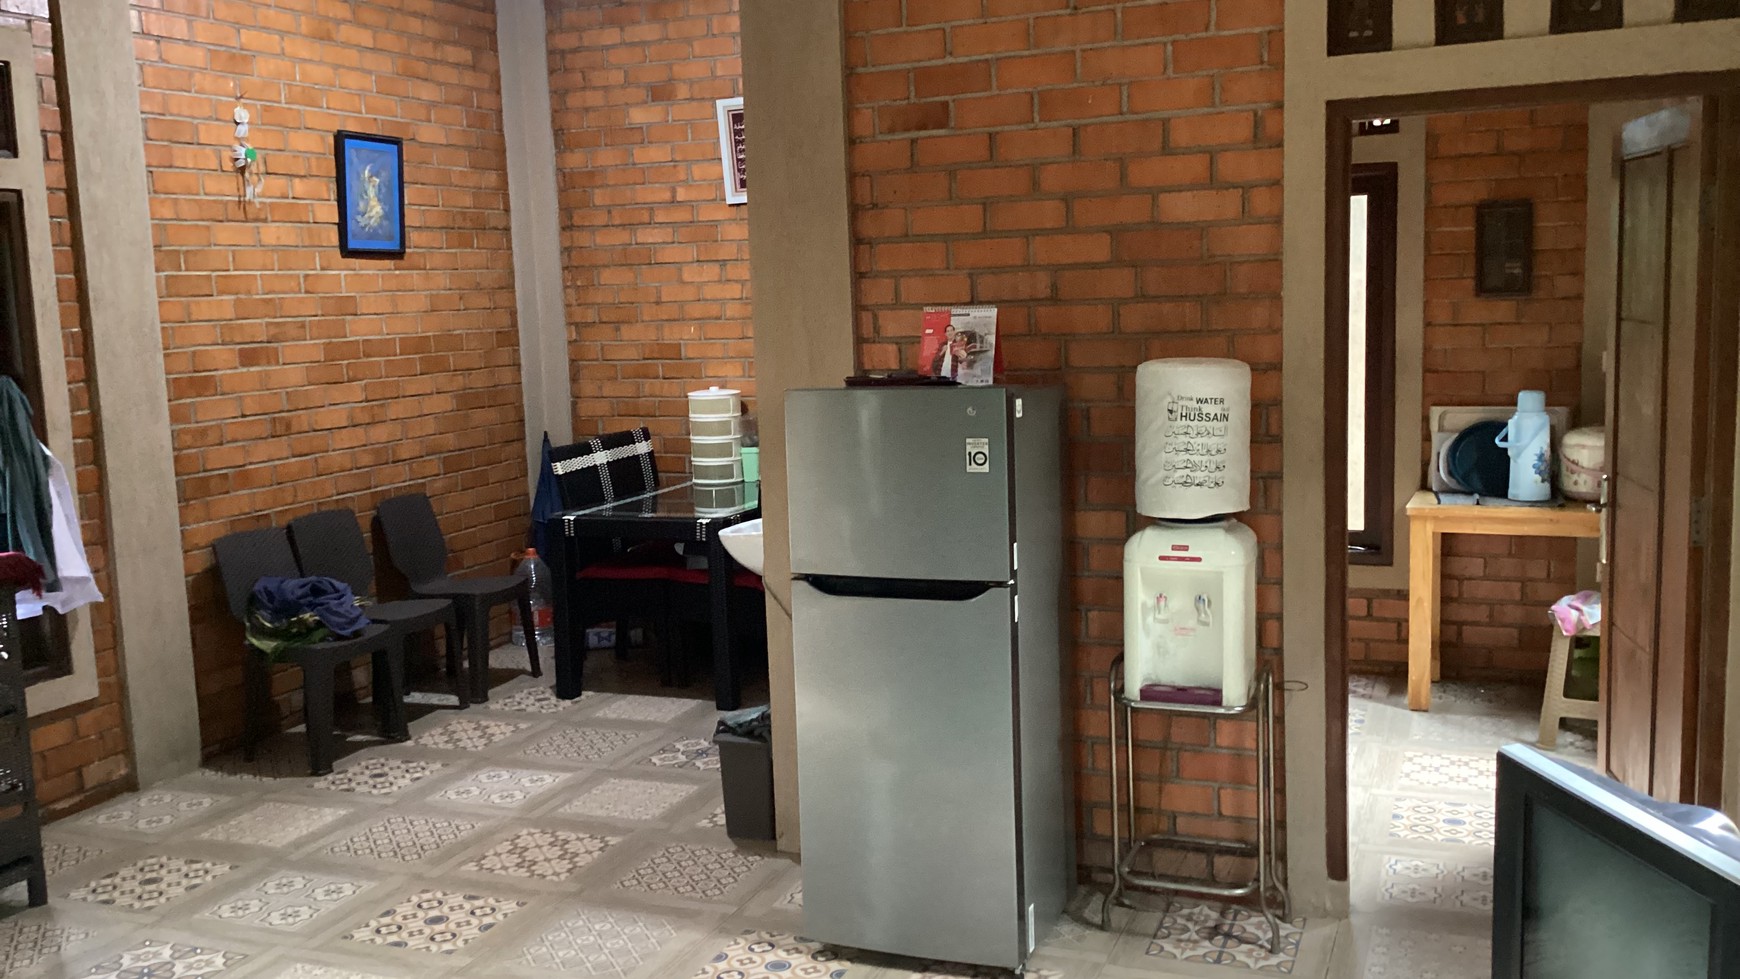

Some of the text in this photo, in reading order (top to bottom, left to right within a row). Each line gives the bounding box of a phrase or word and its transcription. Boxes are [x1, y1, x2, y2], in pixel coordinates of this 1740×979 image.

[1196, 397, 1224, 405] WATER
[1180, 412, 1229, 422] HUSSAIN
[968, 451, 987, 466] 10
